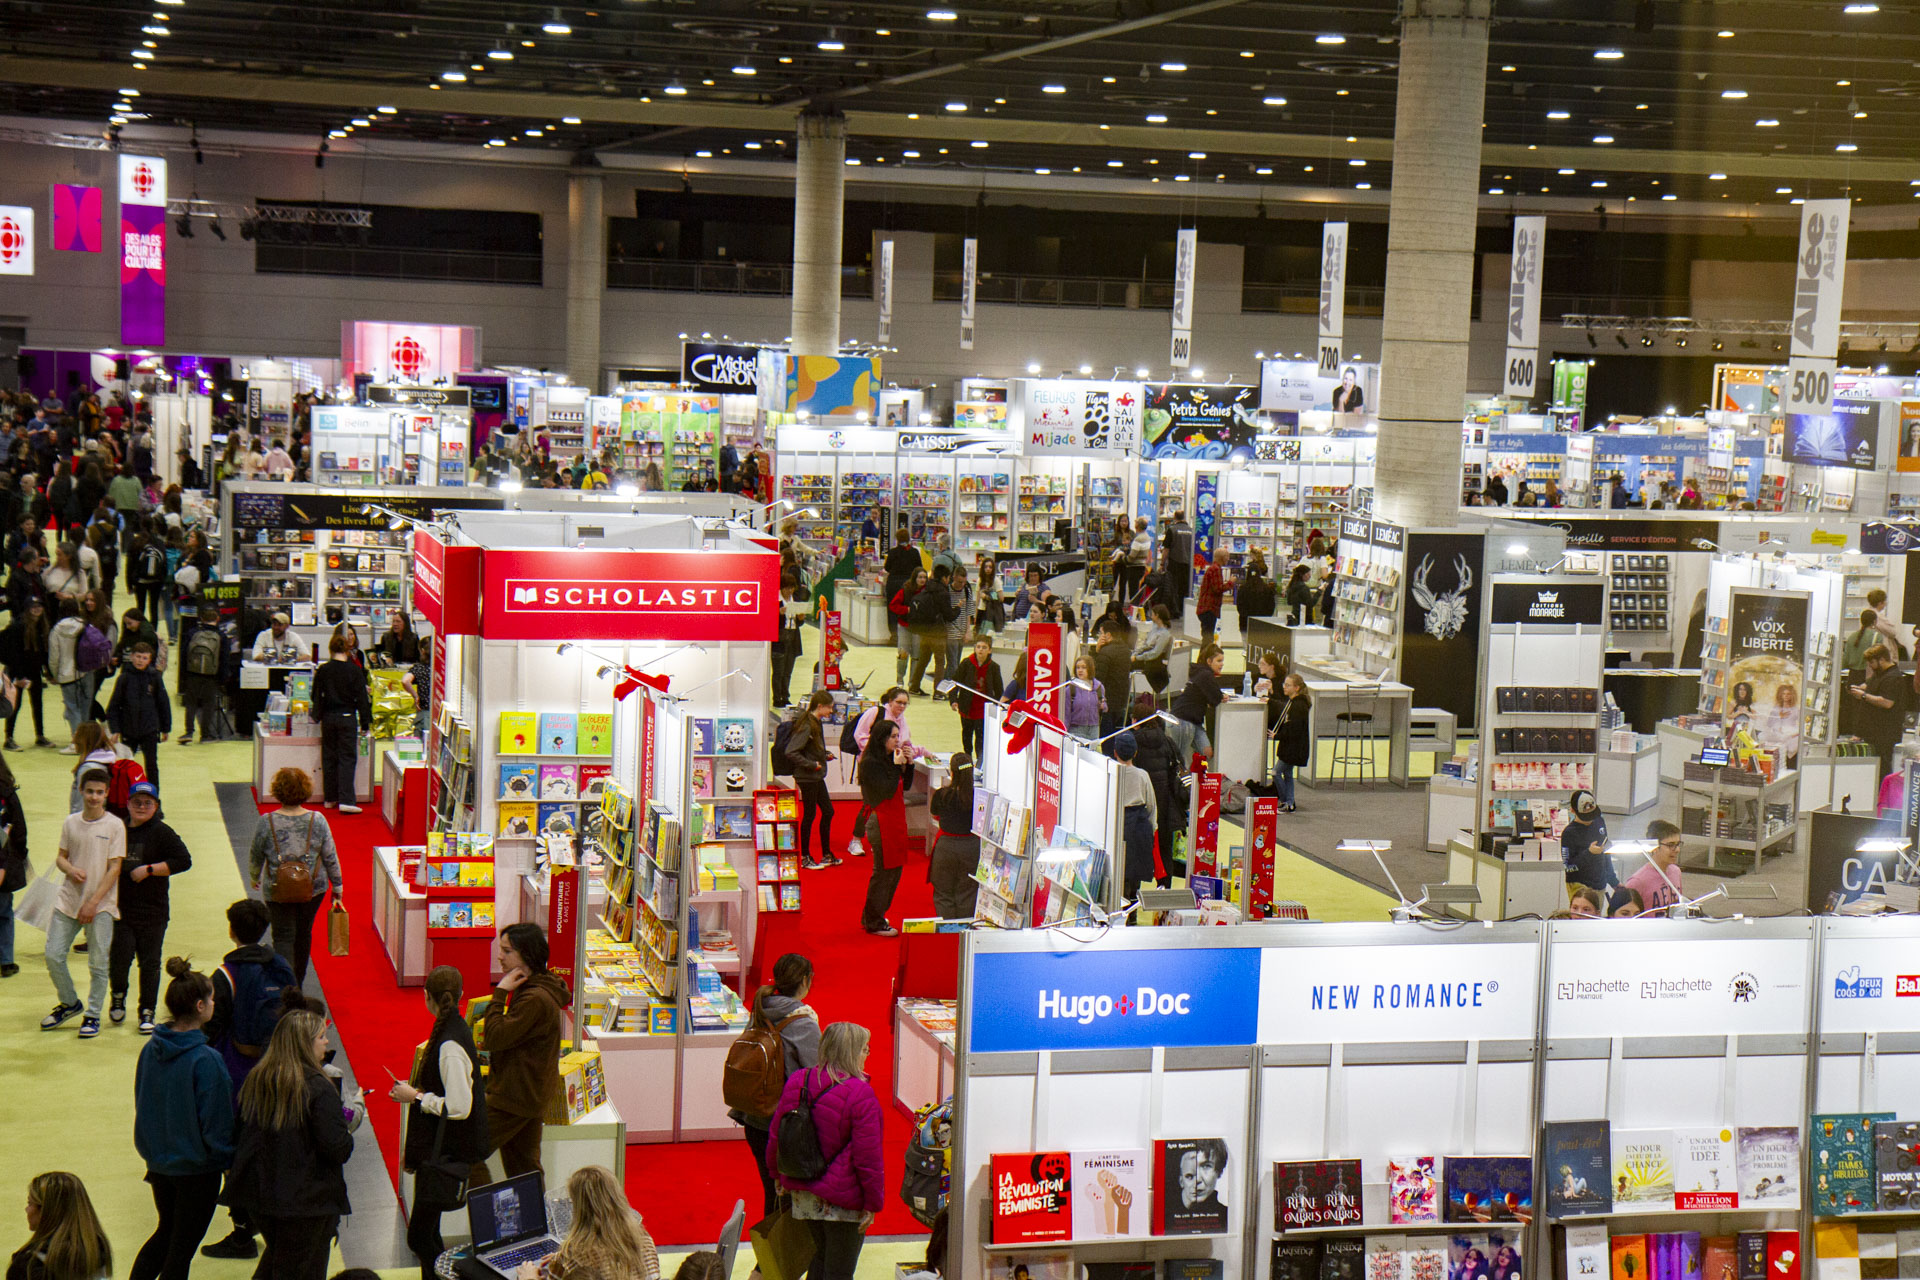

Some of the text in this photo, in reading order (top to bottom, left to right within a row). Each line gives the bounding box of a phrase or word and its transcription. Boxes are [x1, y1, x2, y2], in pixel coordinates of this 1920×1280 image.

[125, 232, 162, 247] DES AILES
[125, 244, 162, 258] POUR LA
[1822, 215, 1839, 281] Aisle
[125, 256, 162, 270] CULTURE
[1526, 230, 1538, 285] Aisle
[1320, 233, 1336, 332] Allée
[1509, 228, 1528, 341] Allée
[1794, 212, 1825, 350] Allée
[1173, 338, 1188, 360] 800
[716, 354, 757, 372] Michel
[1320, 347, 1339, 371] 700
[1509, 358, 1533, 388] 600
[1791, 370, 1829, 405] 500
[250, 389, 261, 419] CAISSE
[1034, 390, 1076, 404] FLEURUS
[1169, 402, 1232, 417] Petits Génies
[899, 434, 957, 450] CAISSE
[1032, 432, 1076, 447] Mijade
[326, 516, 341, 525] Des
[343, 516, 368, 525] livres
[1344, 521, 1368, 538] LEMÉAC
[1375, 527, 1400, 545] LEMÉAC
[1611, 536, 1640, 544] SERVICE
[418, 562, 441, 596] SCHOLASTIC
[544, 587, 753, 606] SCHOLASTIC
[1529, 608, 1565, 618] MONARQUE
[1752, 620, 1785, 634] VOIX
[1742, 637, 1794, 651] LIBERTÉ
[1041, 757, 1060, 773] ALBUMS
[1910, 771, 1920, 827] ROMANCE
[556, 881, 564, 934] DOCUMENTAIRES
[1577, 979, 1630, 992] hachette
[1660, 978, 1712, 991] hachette
[1859, 979, 1881, 988] DEUX
[1311, 985, 1360, 1010] NEW
[1836, 988, 1857, 998] COQS
[1038, 987, 1191, 1025] Hugo Doc
[1640, 1145, 1662, 1153] JOUR
[1691, 1151, 1721, 1161] IDÉE
[1084, 1159, 1135, 1168] FÉMINISME
[1625, 1160, 1662, 1168] CHANCE
[1838, 1160, 1863, 1169] FEMMES
[999, 1172, 1013, 1187] LA
[999, 1193, 1056, 1216] FÉMINISTE
